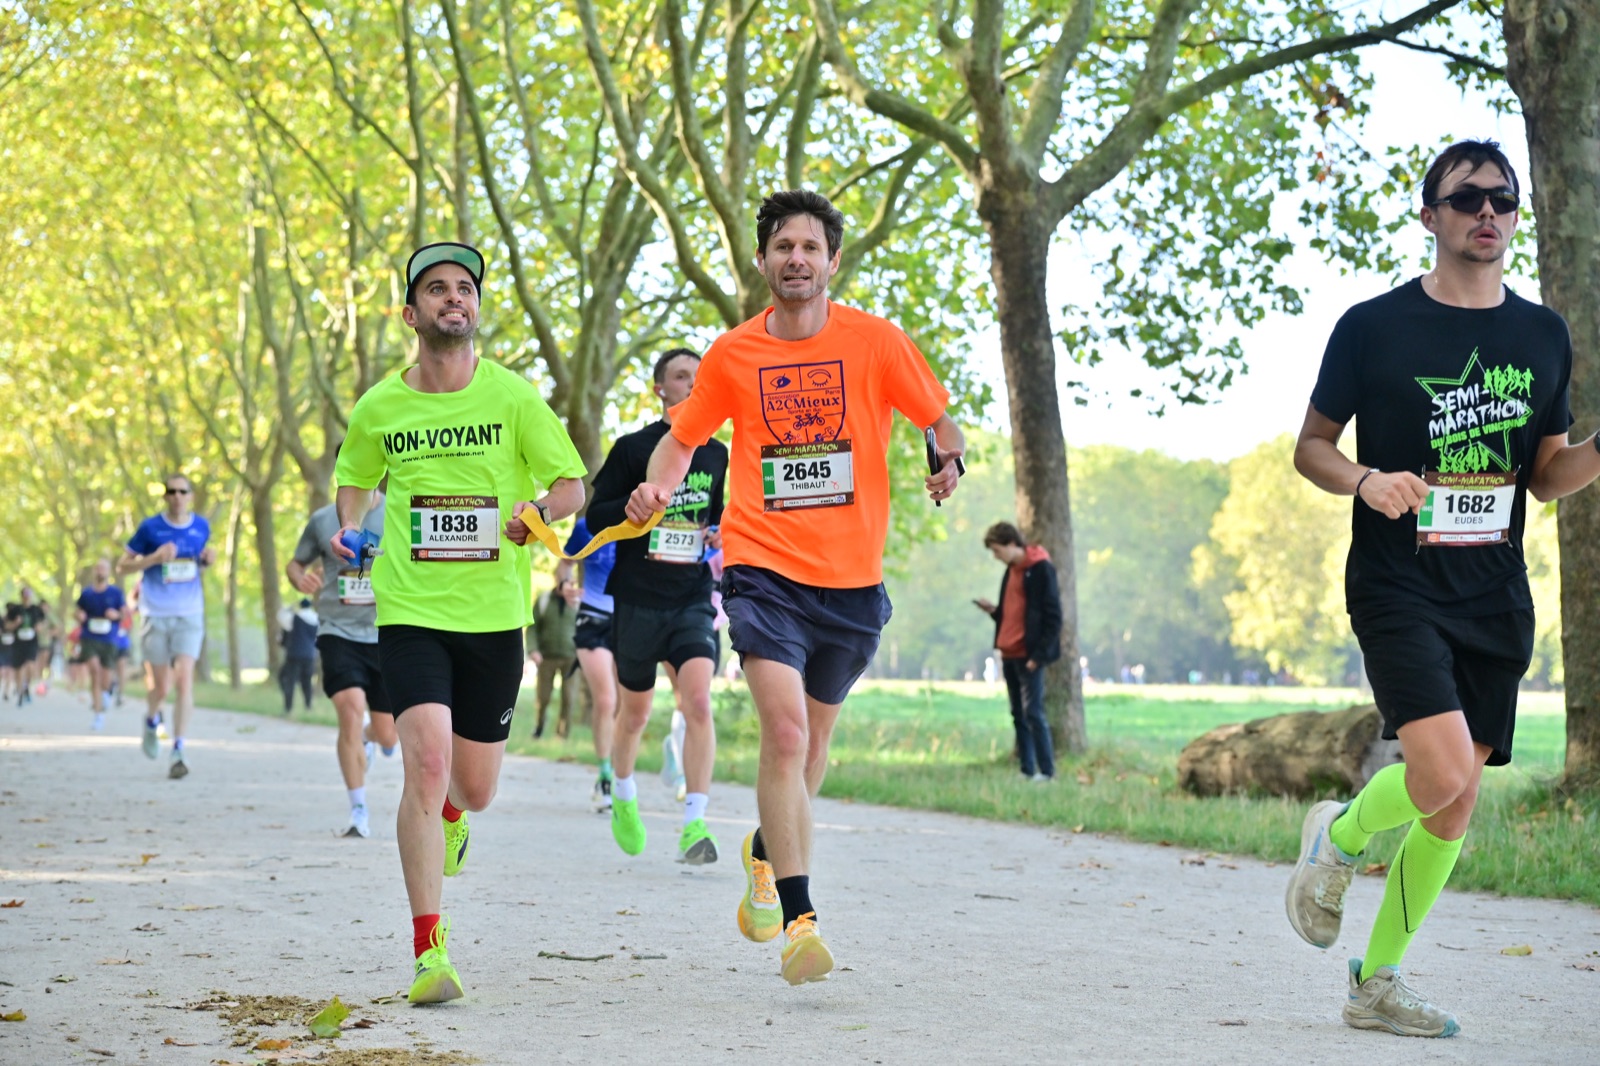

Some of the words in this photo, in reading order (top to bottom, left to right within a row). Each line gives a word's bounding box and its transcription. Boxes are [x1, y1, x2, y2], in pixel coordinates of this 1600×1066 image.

[766, 396, 840, 413] A2CMieux
[1431, 383, 1490, 416] SEMI-
[1428, 399, 1527, 440] MARATHON
[384, 423, 502, 456] NON-VOYANT
[1431, 437, 1444, 450] DU
[1446, 431, 1467, 445] BOIS
[1469, 427, 1481, 439] DE
[401, 450, 485, 463] www.courir-en-duo.net
[773, 443, 839, 456] SEMI-MARATHON
[783, 460, 832, 482] 2645
[791, 481, 826, 490] THIBAUT
[1436, 475, 1506, 485] SEMI-MARATHON
[422, 497, 486, 507] SEMI-MARATHON
[1445, 494, 1496, 514] 1682
[430, 514, 478, 533] 1838
[1454, 516, 1484, 525] EUDES
[429, 534, 479, 542] ALEXANDRE
[665, 532, 694, 546] 2573
[350, 580, 372, 590] 272
